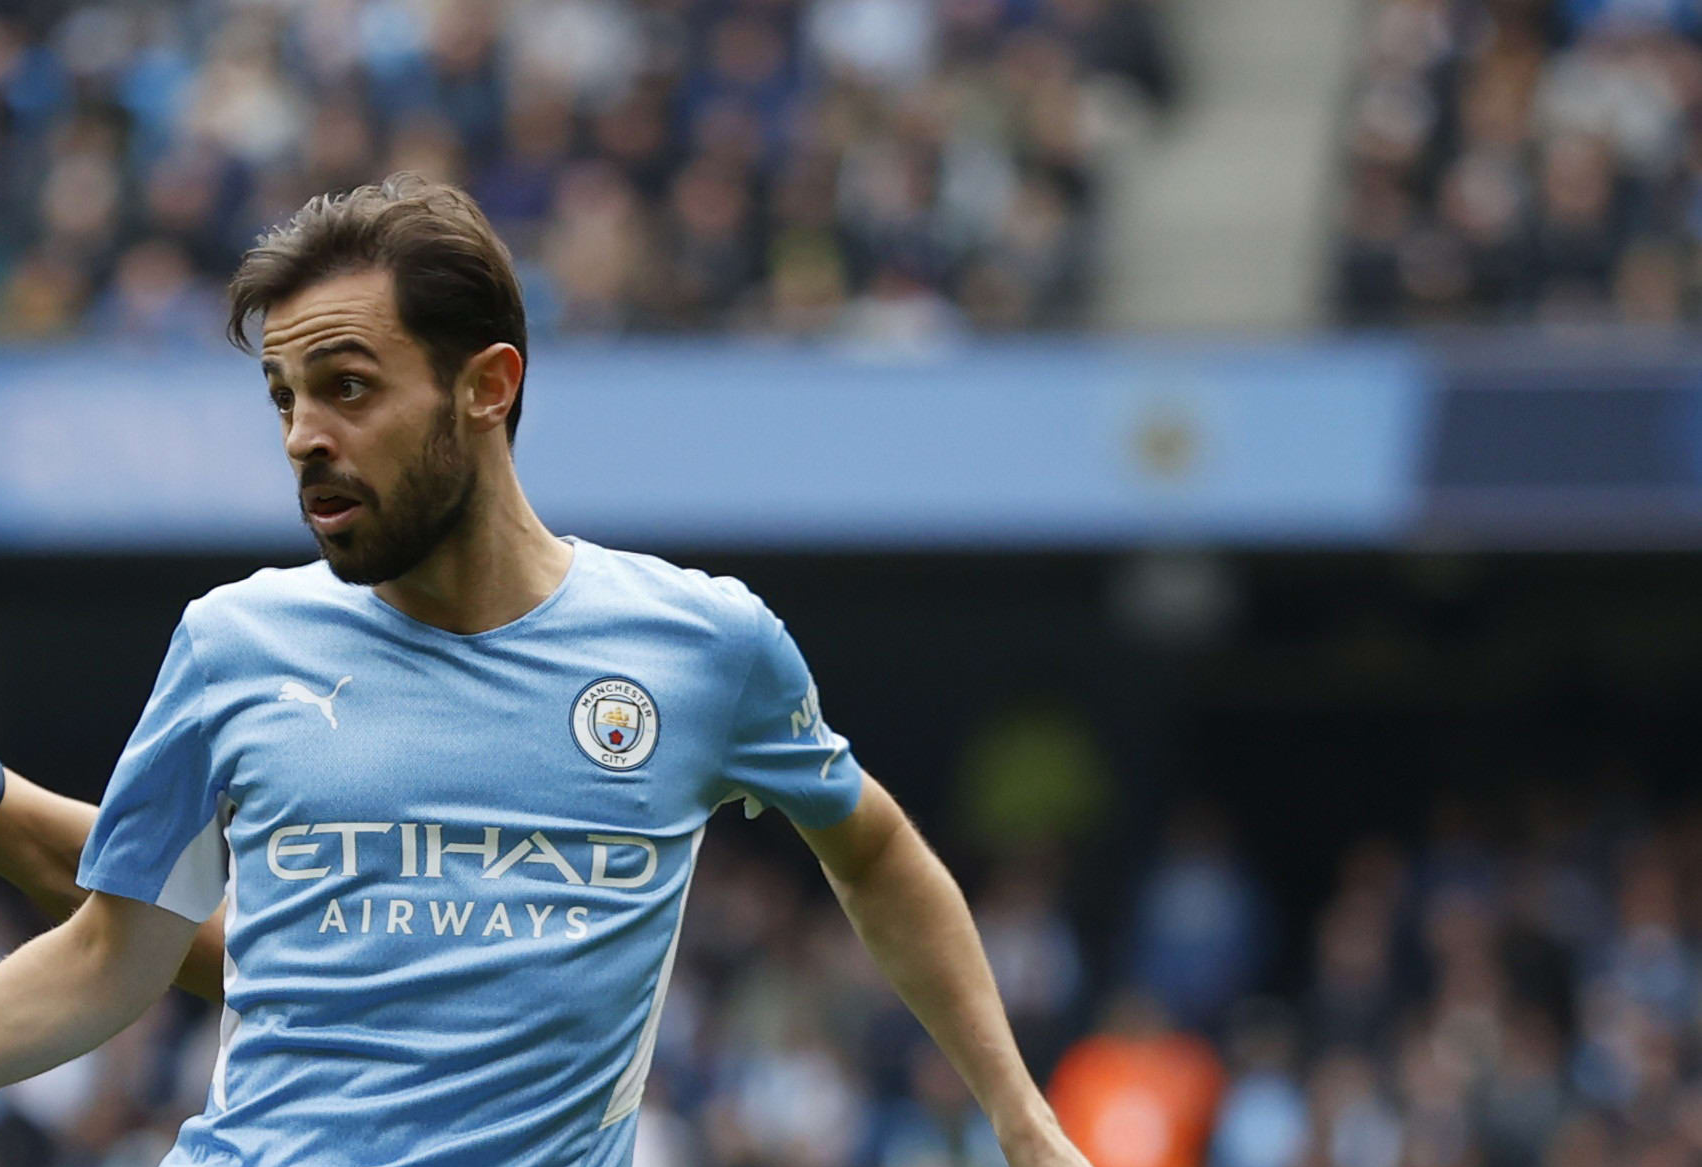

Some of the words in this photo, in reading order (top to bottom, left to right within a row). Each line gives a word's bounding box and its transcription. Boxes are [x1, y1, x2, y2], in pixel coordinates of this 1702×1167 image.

[581, 684, 652, 718] MANCHESTER
[601, 753, 628, 765] CITY
[266, 822, 659, 889] ETIHAD
[318, 898, 590, 940] AIRWAYS
